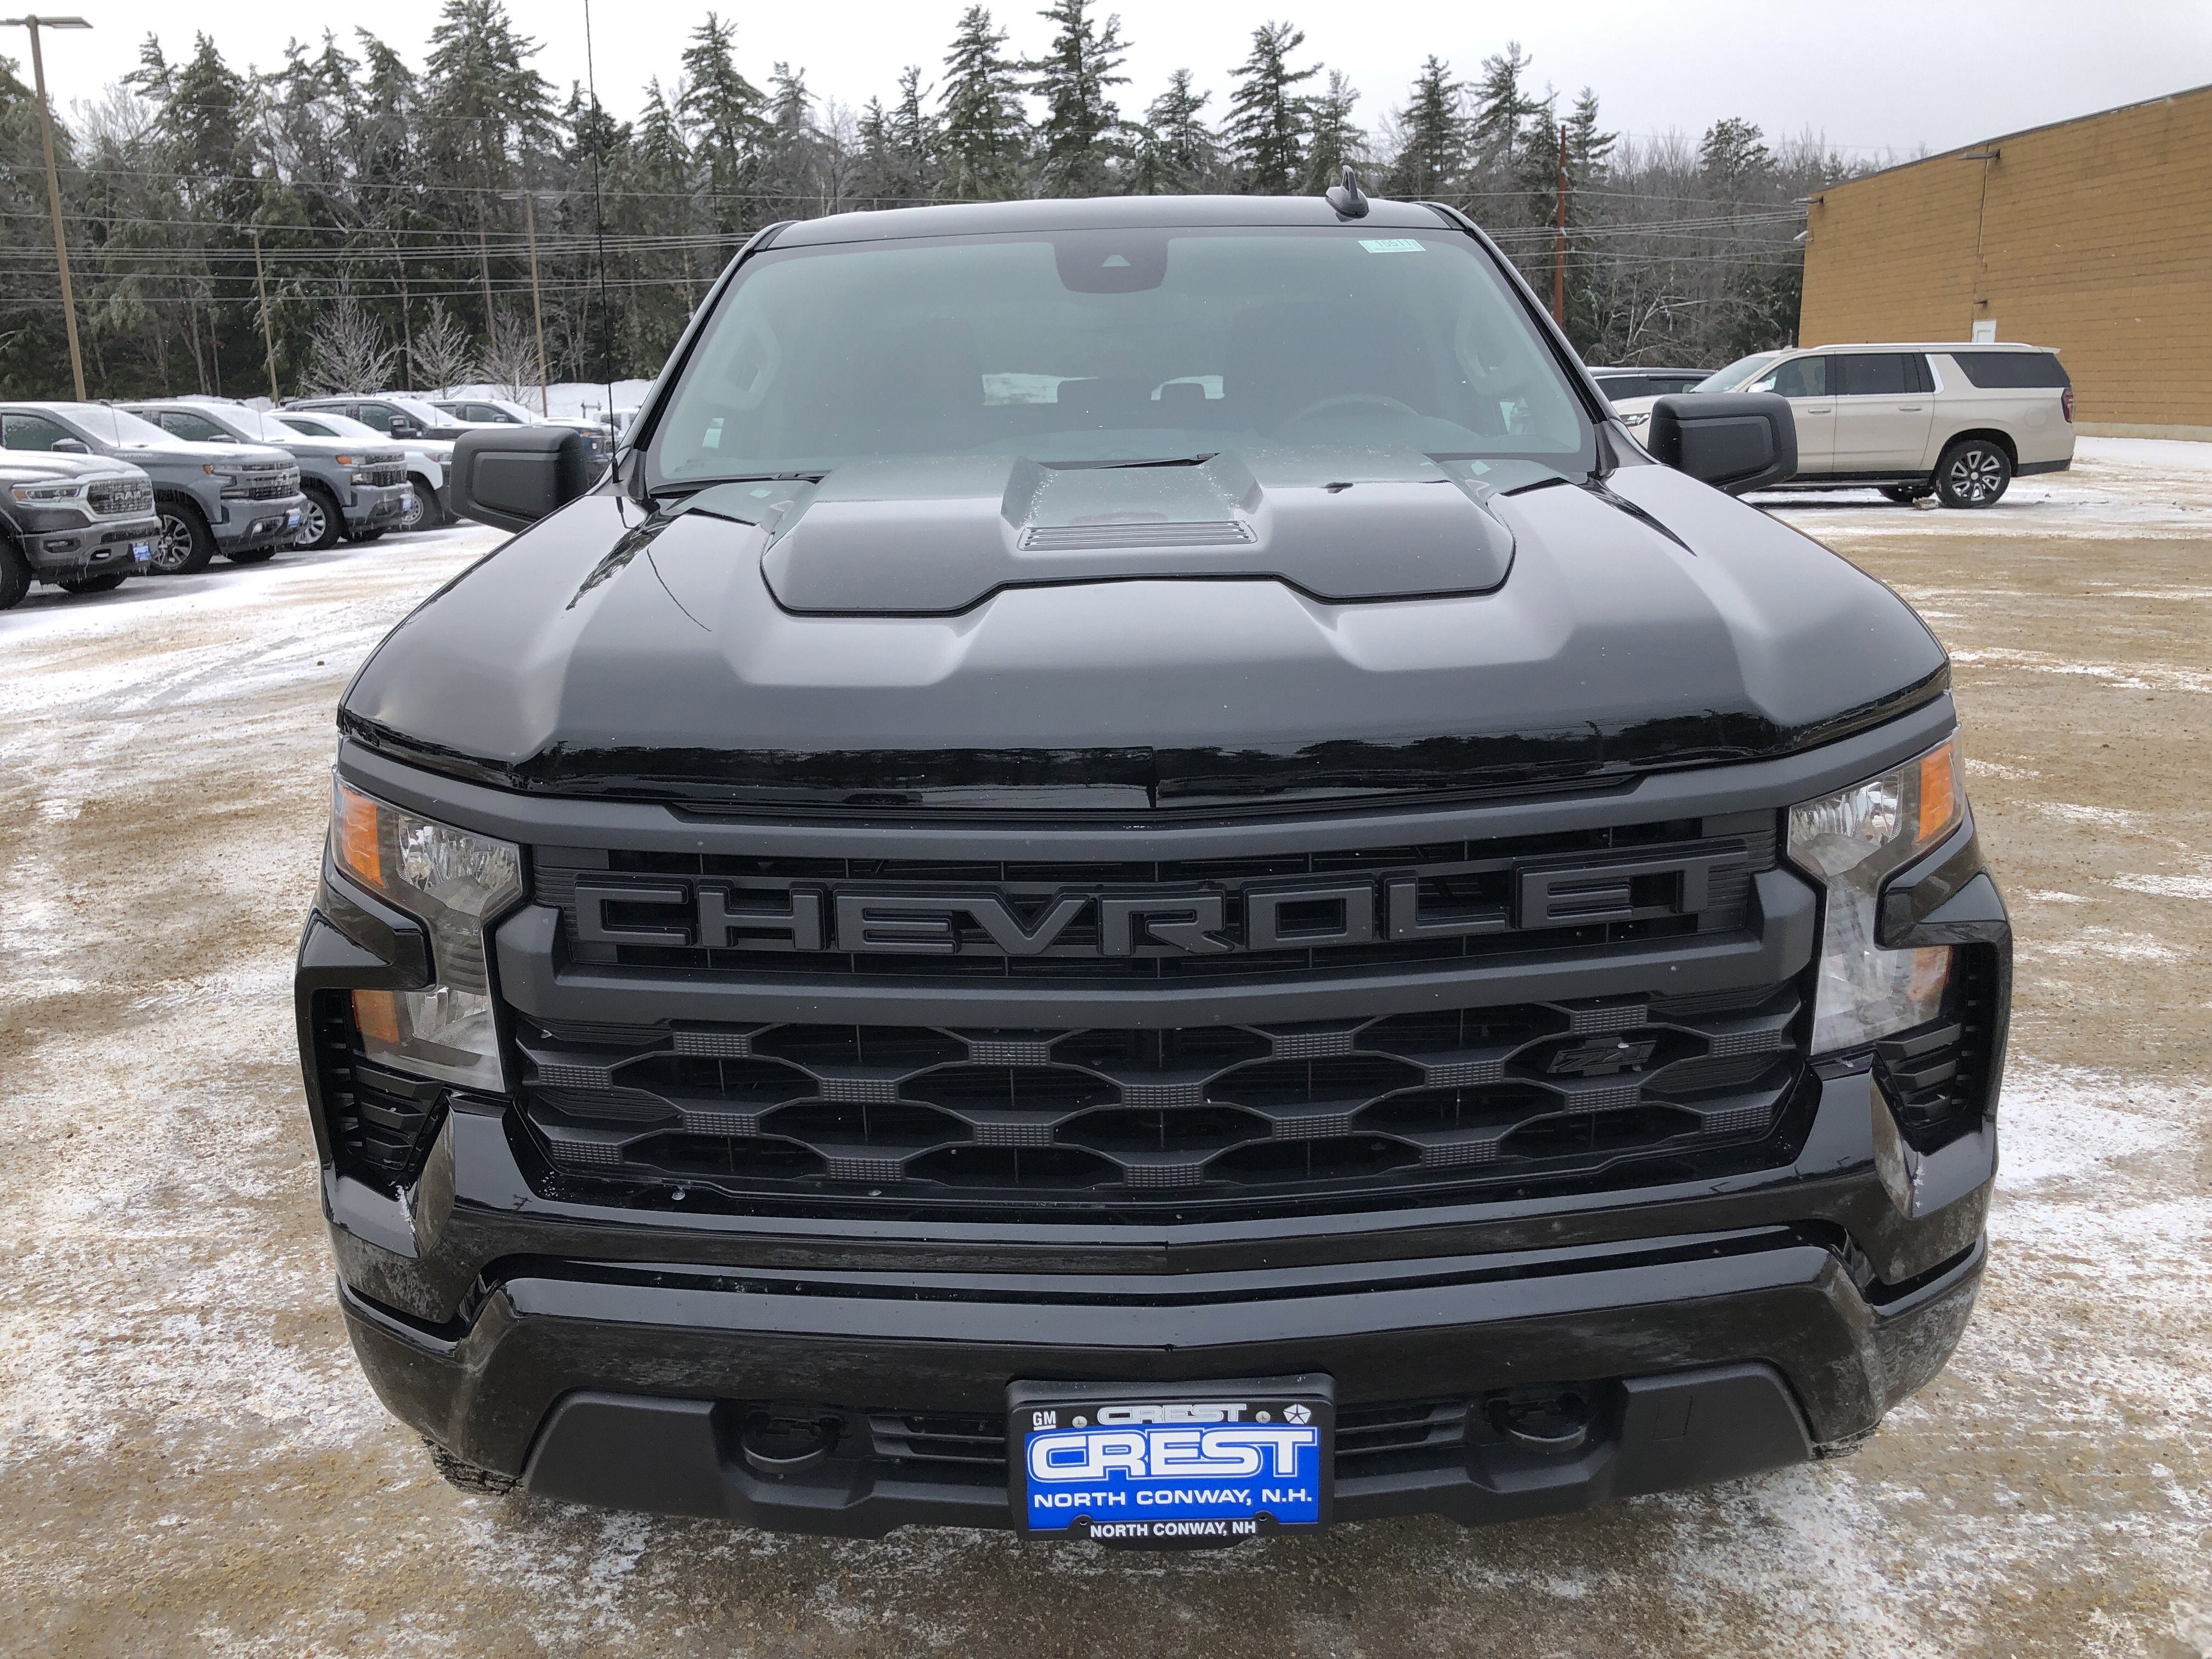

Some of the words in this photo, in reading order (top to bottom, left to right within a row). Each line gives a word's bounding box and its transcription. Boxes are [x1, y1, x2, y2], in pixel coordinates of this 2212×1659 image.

[115, 490, 142, 500] RAM
[574, 840, 1749, 956] CHEVROLET
[1033, 1410, 1056, 1426] GM
[1097, 1404, 1246, 1425] CREST
[1028, 1427, 1318, 1482] CREST
[1034, 1491, 1126, 1508] NORTH
[1136, 1489, 1252, 1506] CONWAY,
[1262, 1488, 1312, 1503] N.H.
[1090, 1523, 1148, 1538] NORTH
[1153, 1522, 1227, 1537] CONWAY,
[1232, 1521, 1256, 1535] NH
